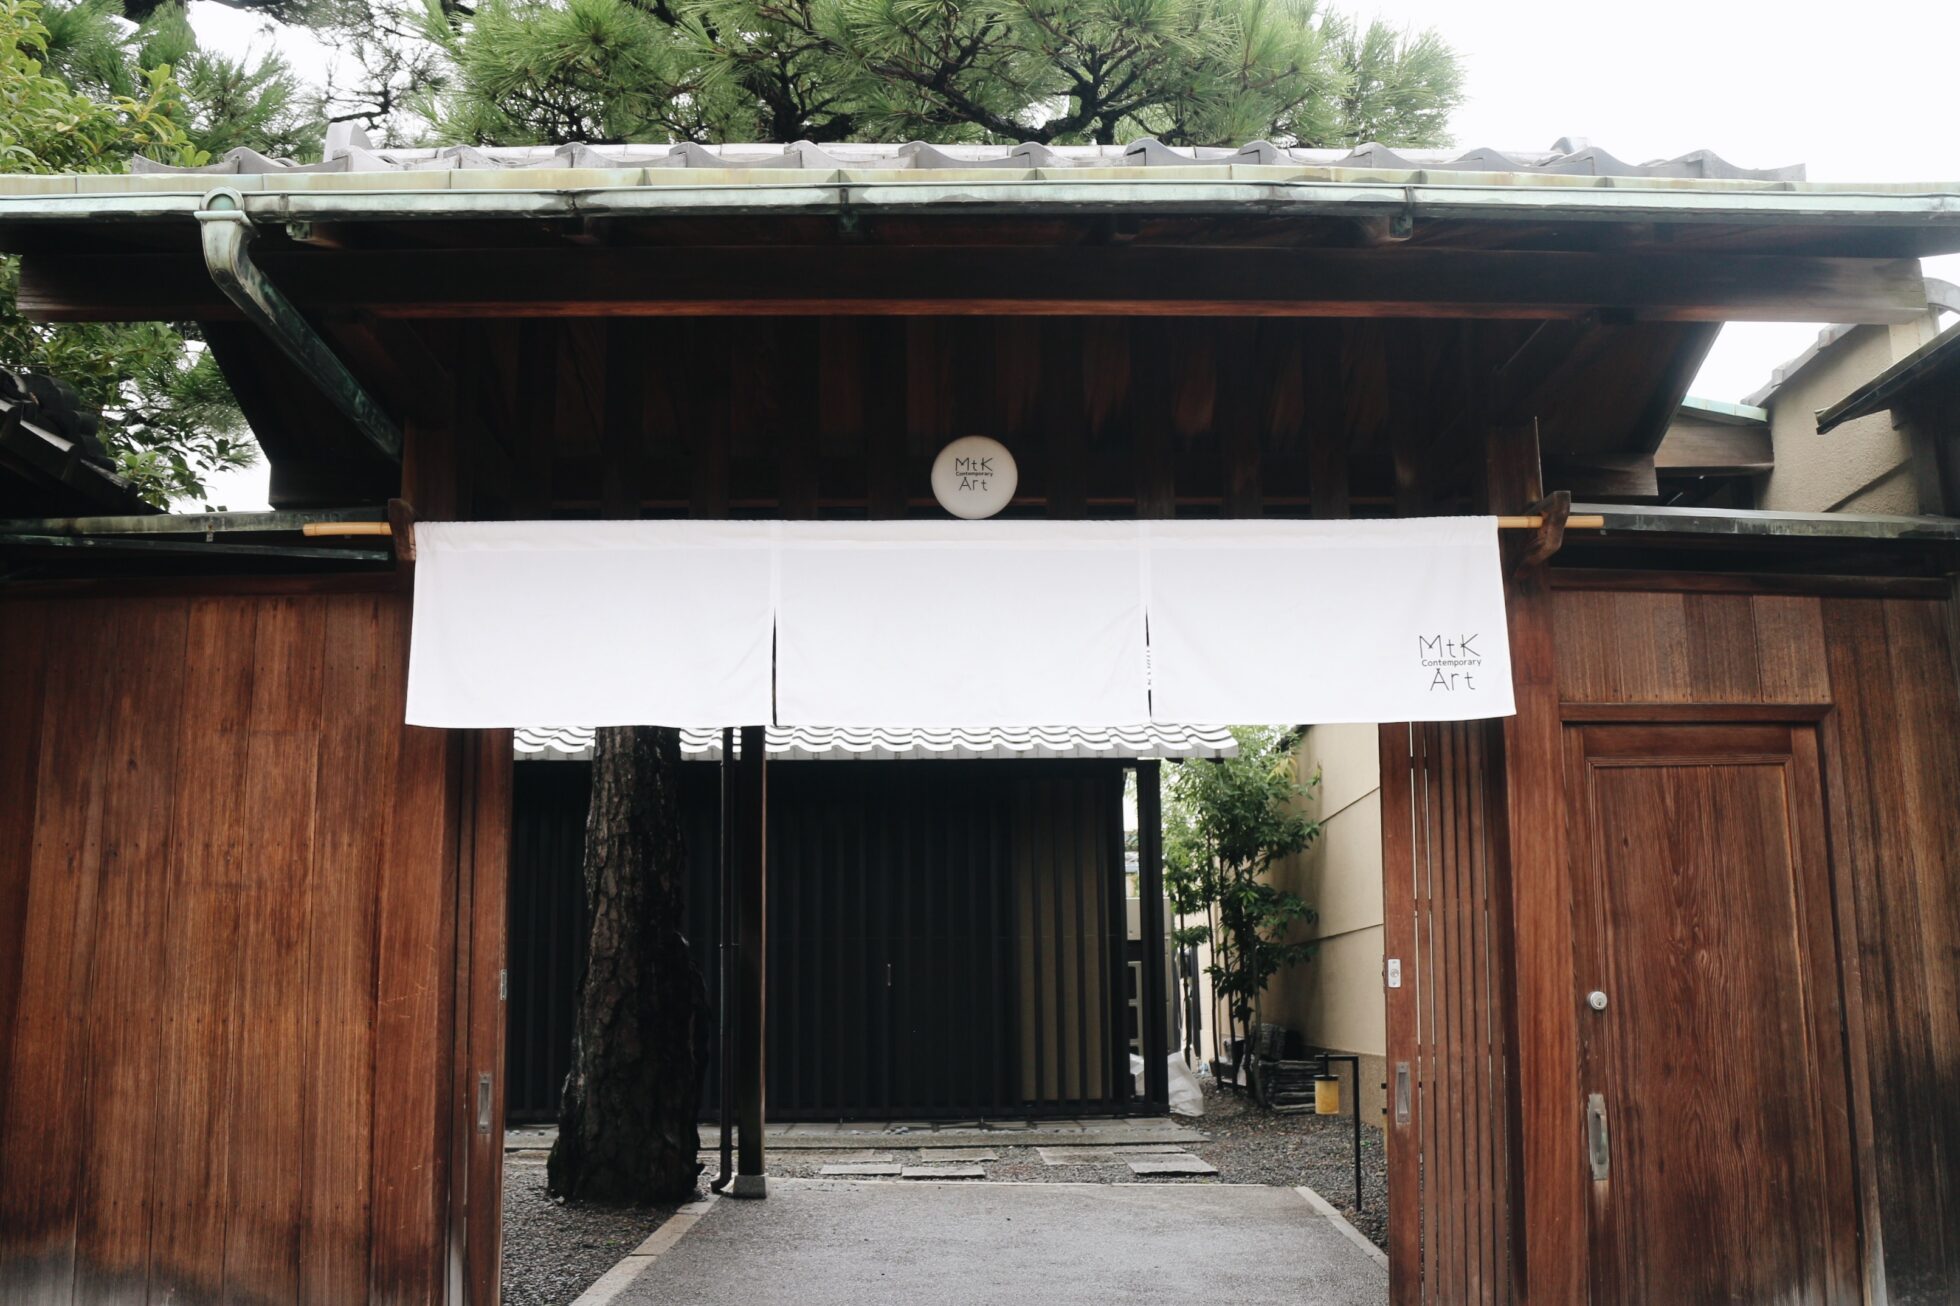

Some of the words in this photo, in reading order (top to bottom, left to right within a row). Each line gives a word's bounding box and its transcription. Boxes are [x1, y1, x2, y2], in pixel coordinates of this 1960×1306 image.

[955, 457, 993, 471] MtK
[959, 477, 987, 491] Art
[1419, 633, 1481, 659] MtK
[1421, 659, 1482, 668] Contemporary
[1430, 668, 1476, 691] Art
